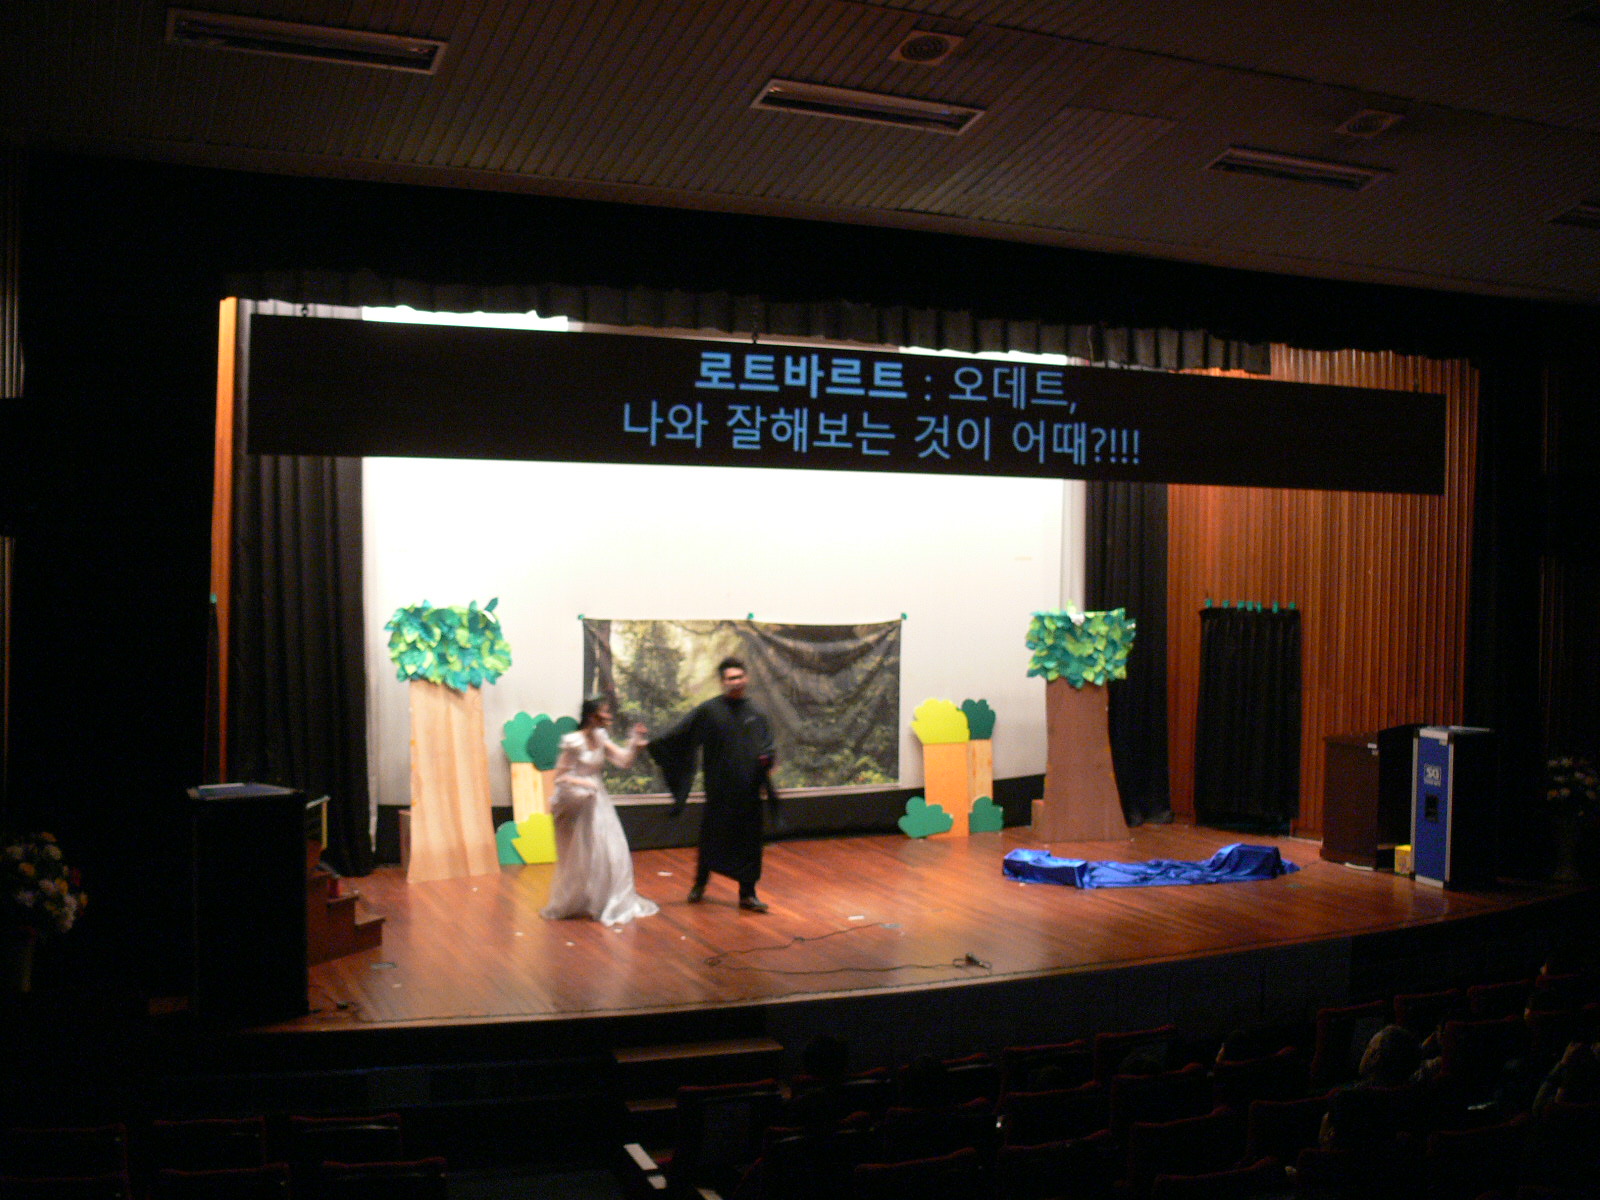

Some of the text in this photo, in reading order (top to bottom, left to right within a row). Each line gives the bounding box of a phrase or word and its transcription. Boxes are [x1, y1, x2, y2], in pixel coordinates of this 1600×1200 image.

[695, 351, 908, 399] 로트바르트
[948, 366, 1078, 413] 오데트,
[623, 400, 1140, 465] 나와 잘해보는 것이 어때?!!!
